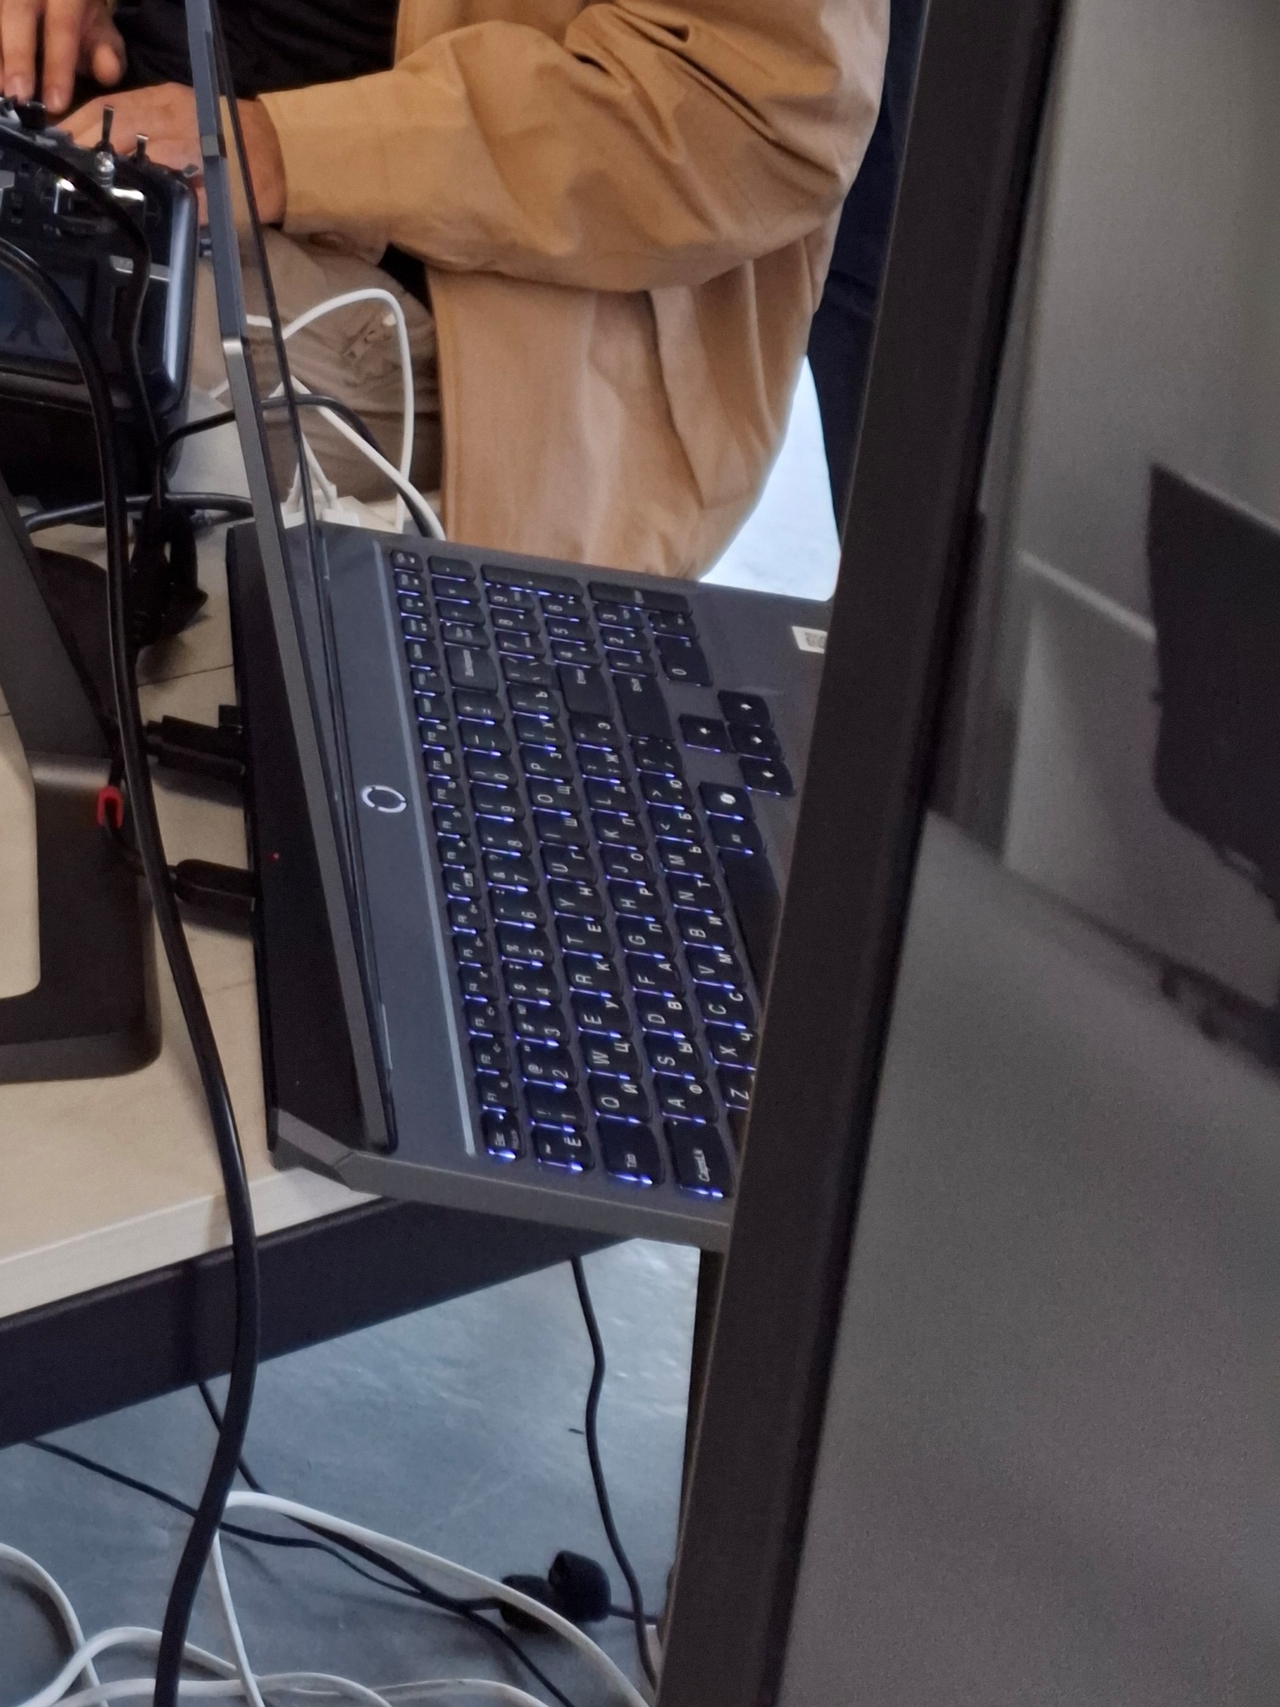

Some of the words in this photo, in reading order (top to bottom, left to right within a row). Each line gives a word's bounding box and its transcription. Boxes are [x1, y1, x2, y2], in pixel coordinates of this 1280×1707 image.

[529, 762, 546, 771] P
[492, 772, 510, 781] 0
[536, 793, 554, 804] O
[500, 805, 516, 813] 9
[603, 829, 620, 839] K
[507, 839, 523, 848] 8
[668, 854, 686, 866] M
[551, 862, 569, 873] U
[612, 864, 629, 874] J
[513, 874, 529, 882] 7
[678, 890, 695, 901] N
[558, 898, 576, 907] Y
[620, 898, 637, 909] H
[521, 911, 537, 919] 6
[688, 927, 707, 939] B
[566, 934, 584, 944] T
[628, 935, 646, 946] G
[528, 948, 545, 957] 5
[697, 964, 715, 974] V
[575, 973, 593, 985] R
[637, 974, 656, 985] F
[536, 987, 551, 996] 4
[707, 1003, 727, 1015] C
[583, 1013, 602, 1025] E
[647, 1013, 666, 1025] D
[543, 1027, 561, 1037] 3
[719, 1045, 738, 1057] X
[592, 1050, 610, 1065] W
[656, 1055, 676, 1066] S
[551, 1069, 569, 1079] 2
[731, 1089, 750, 1100] Z
[667, 1098, 686, 1109] A
